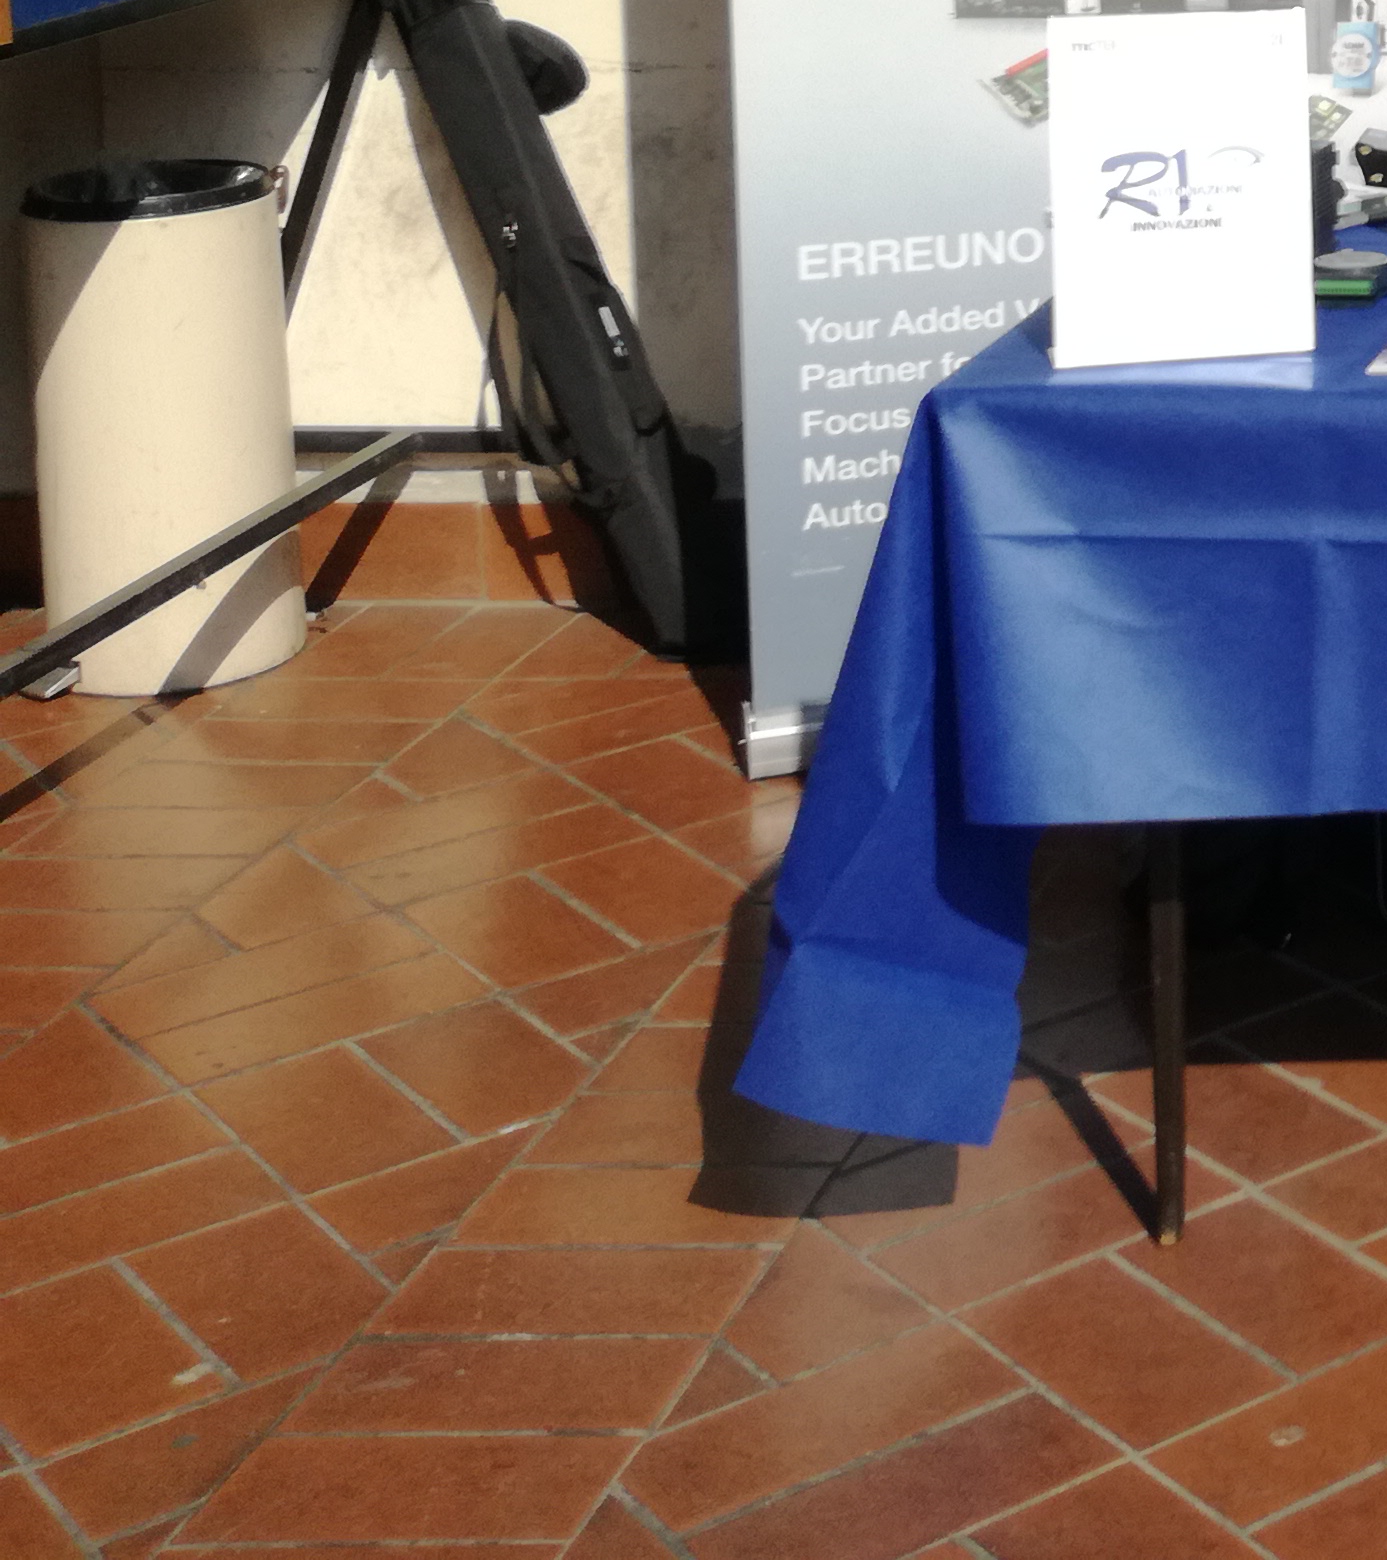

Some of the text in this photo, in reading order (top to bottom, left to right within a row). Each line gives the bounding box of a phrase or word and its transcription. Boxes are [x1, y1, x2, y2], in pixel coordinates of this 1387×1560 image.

[798, 227, 1044, 281] ERREUNO
[797, 304, 1006, 346] Your Added
[800, 357, 926, 391] Partner
[802, 405, 911, 437] Focus
[803, 499, 888, 531] Auto
